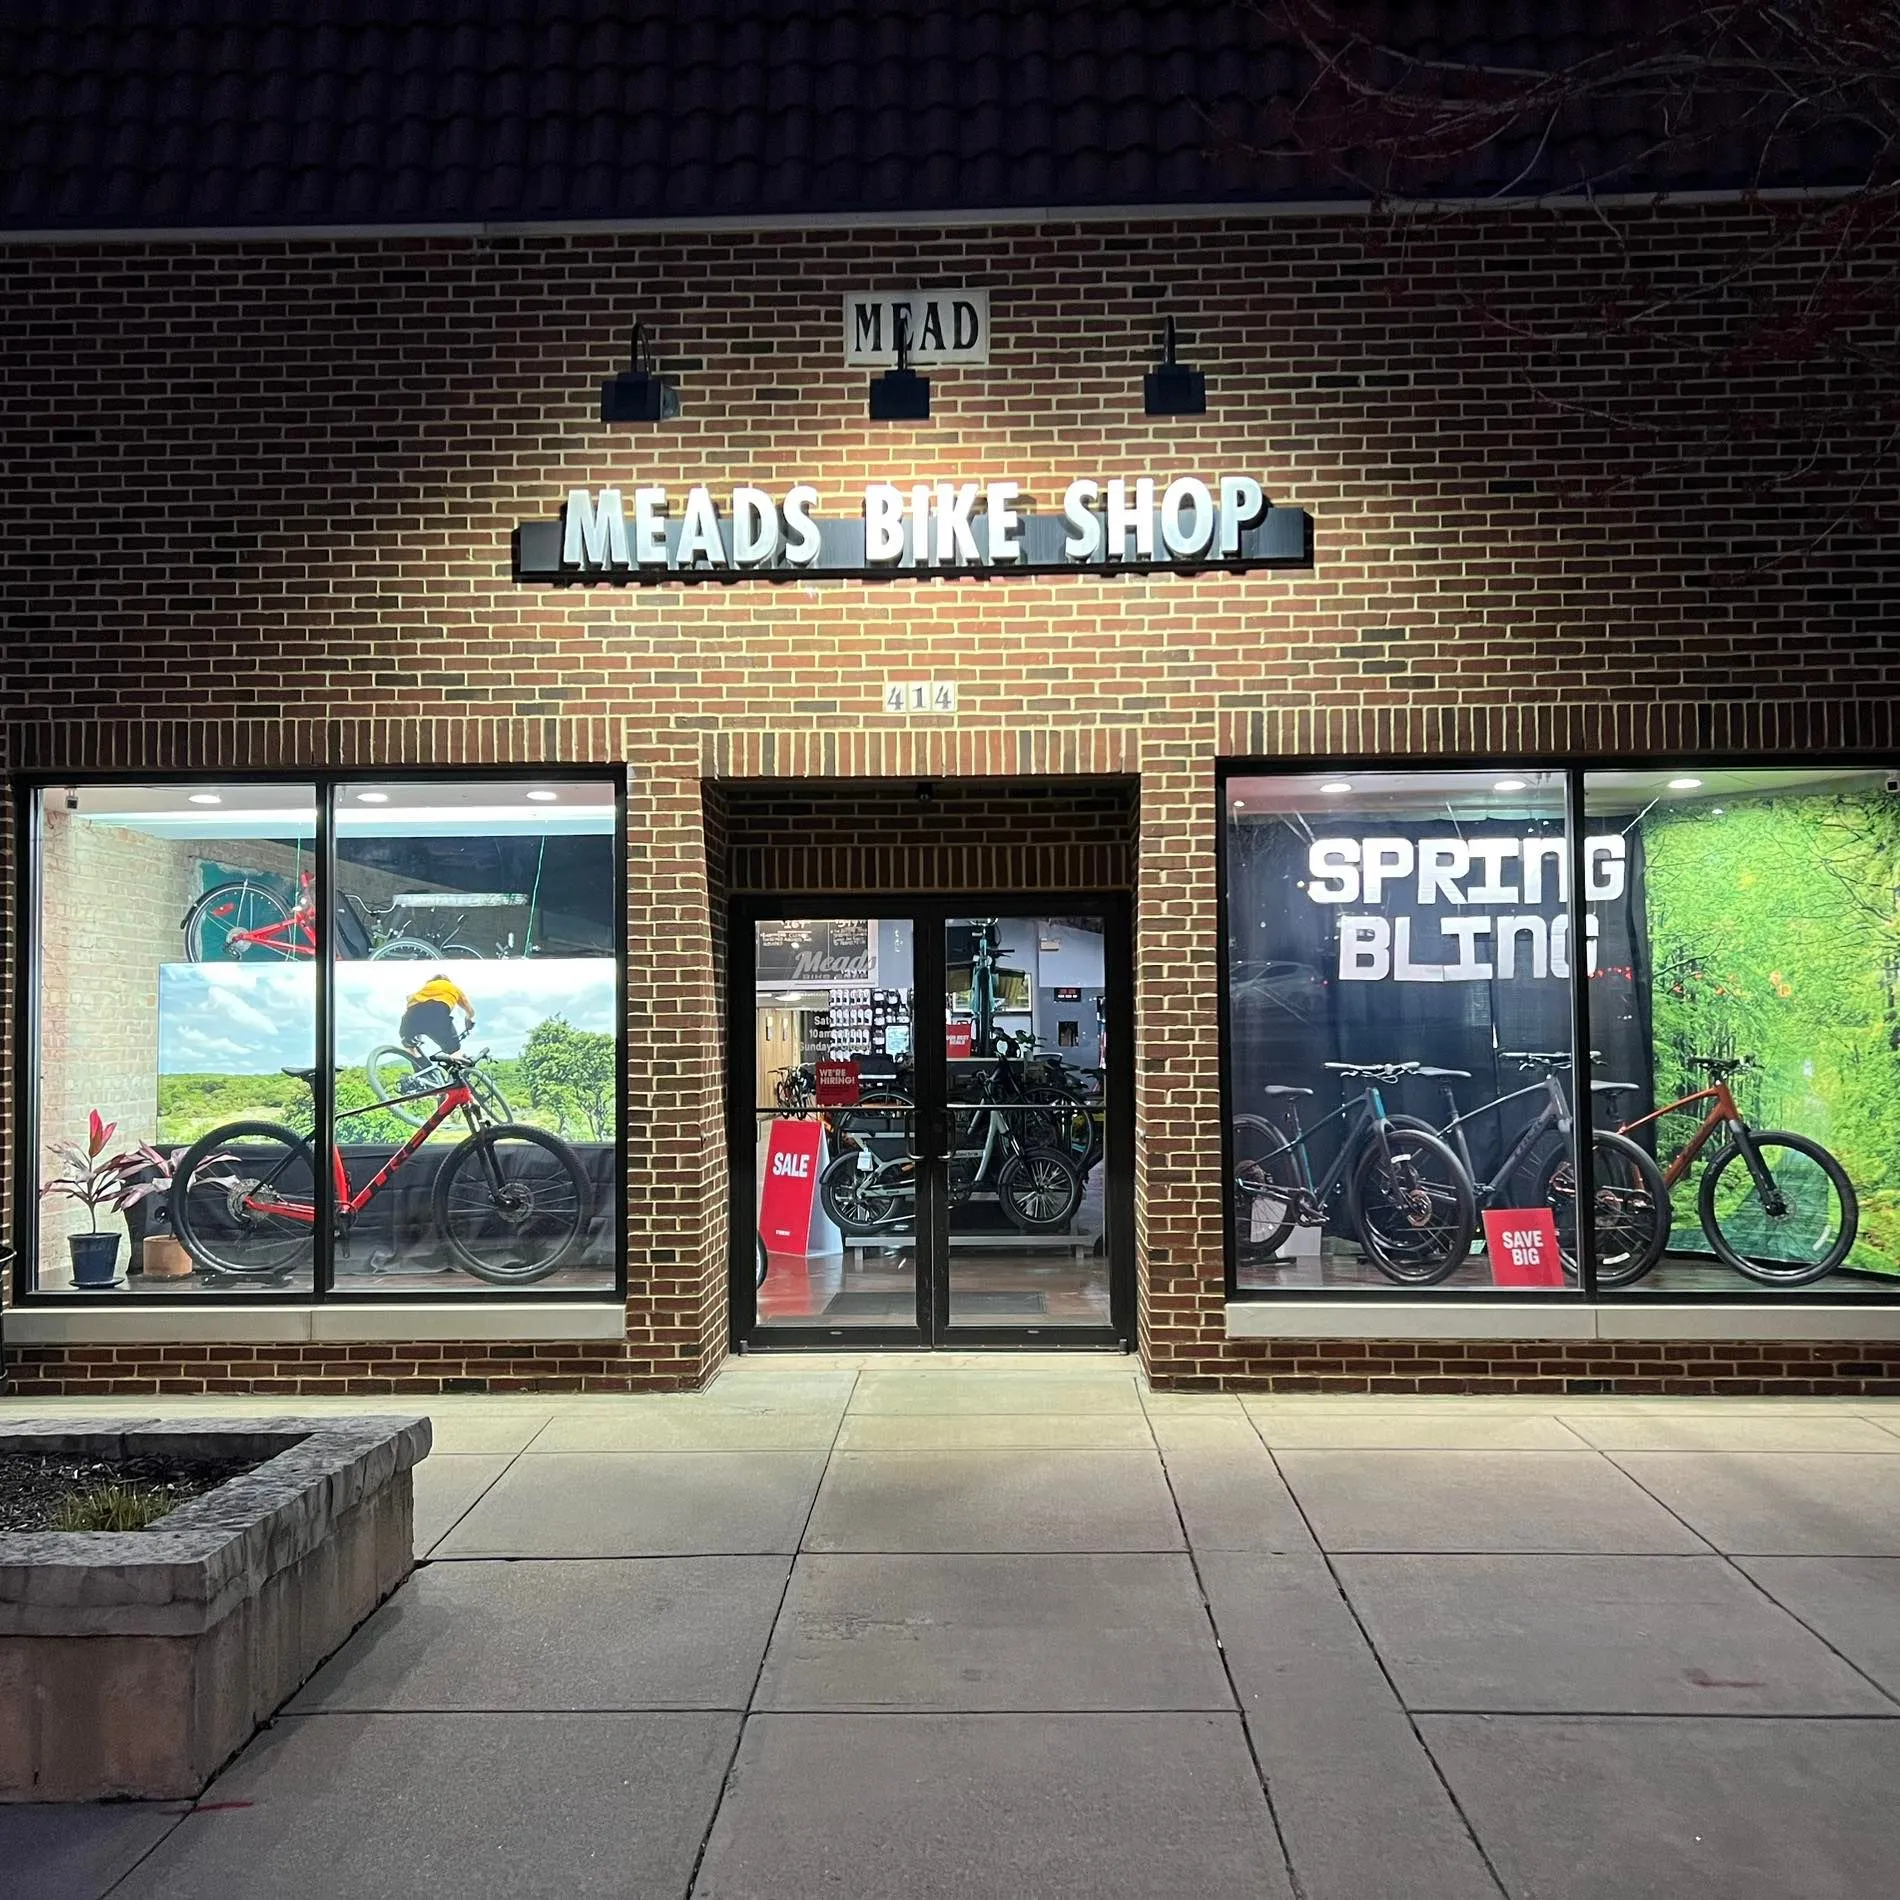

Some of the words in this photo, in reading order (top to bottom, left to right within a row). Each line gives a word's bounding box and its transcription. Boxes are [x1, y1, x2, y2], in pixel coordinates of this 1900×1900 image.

[855, 301, 979, 352] MEAD
[563, 486, 821, 566] MEADS
[864, 482, 1021, 562] BIKE
[1063, 476, 1263, 560] SHOP
[887, 685, 952, 711] 414
[1306, 834, 1626, 905] SPRING
[1338, 913, 1600, 982] BLING
[819, 1069, 847, 1077] WE'RE
[820, 1076, 855, 1085] HIRING!
[772, 1152, 810, 1178] SALE
[1502, 1230, 1544, 1249] SAVE
[1511, 1249, 1540, 1266] BIG
